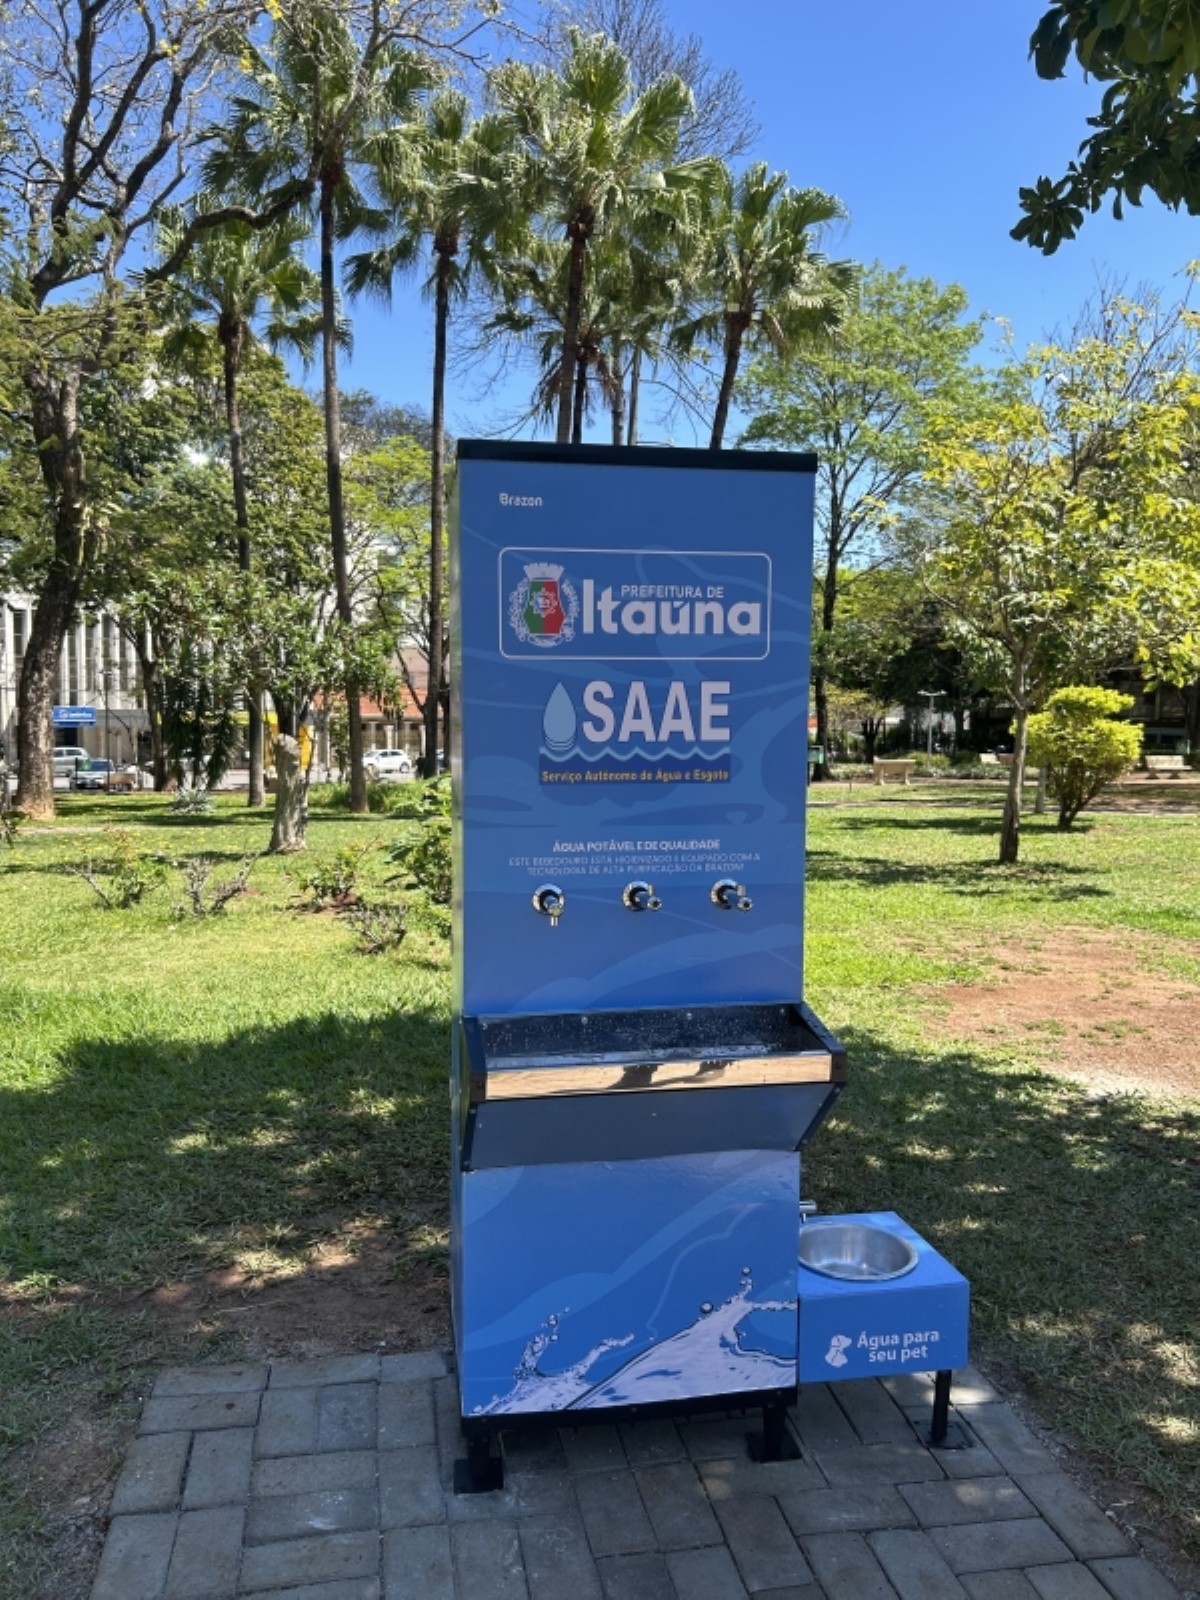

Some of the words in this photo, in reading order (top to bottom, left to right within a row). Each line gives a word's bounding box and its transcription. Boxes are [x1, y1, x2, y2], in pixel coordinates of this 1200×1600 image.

[621, 585, 702, 598] PREFEITURA
[707, 586, 724, 598] DE
[583, 579, 761, 635] Itaúna
[582, 680, 731, 742] SAAE
[541, 771, 582, 783] Serviço
[639, 770, 652, 781] de
[655, 768, 682, 782] Água
[685, 771, 691, 780] e
[694, 769, 728, 781] Esgoto
[552, 839, 585, 852] ÁGUA
[587, 839, 635, 852] POTÁVEL
[637, 841, 643, 851] E
[645, 841, 658, 851] DE
[660, 839, 720, 852] QUALIDADE
[857, 1331, 899, 1350] Água
[903, 1331, 940, 1348] para
[869, 1349, 896, 1362] seu
[901, 1345, 928, 1363] pet
